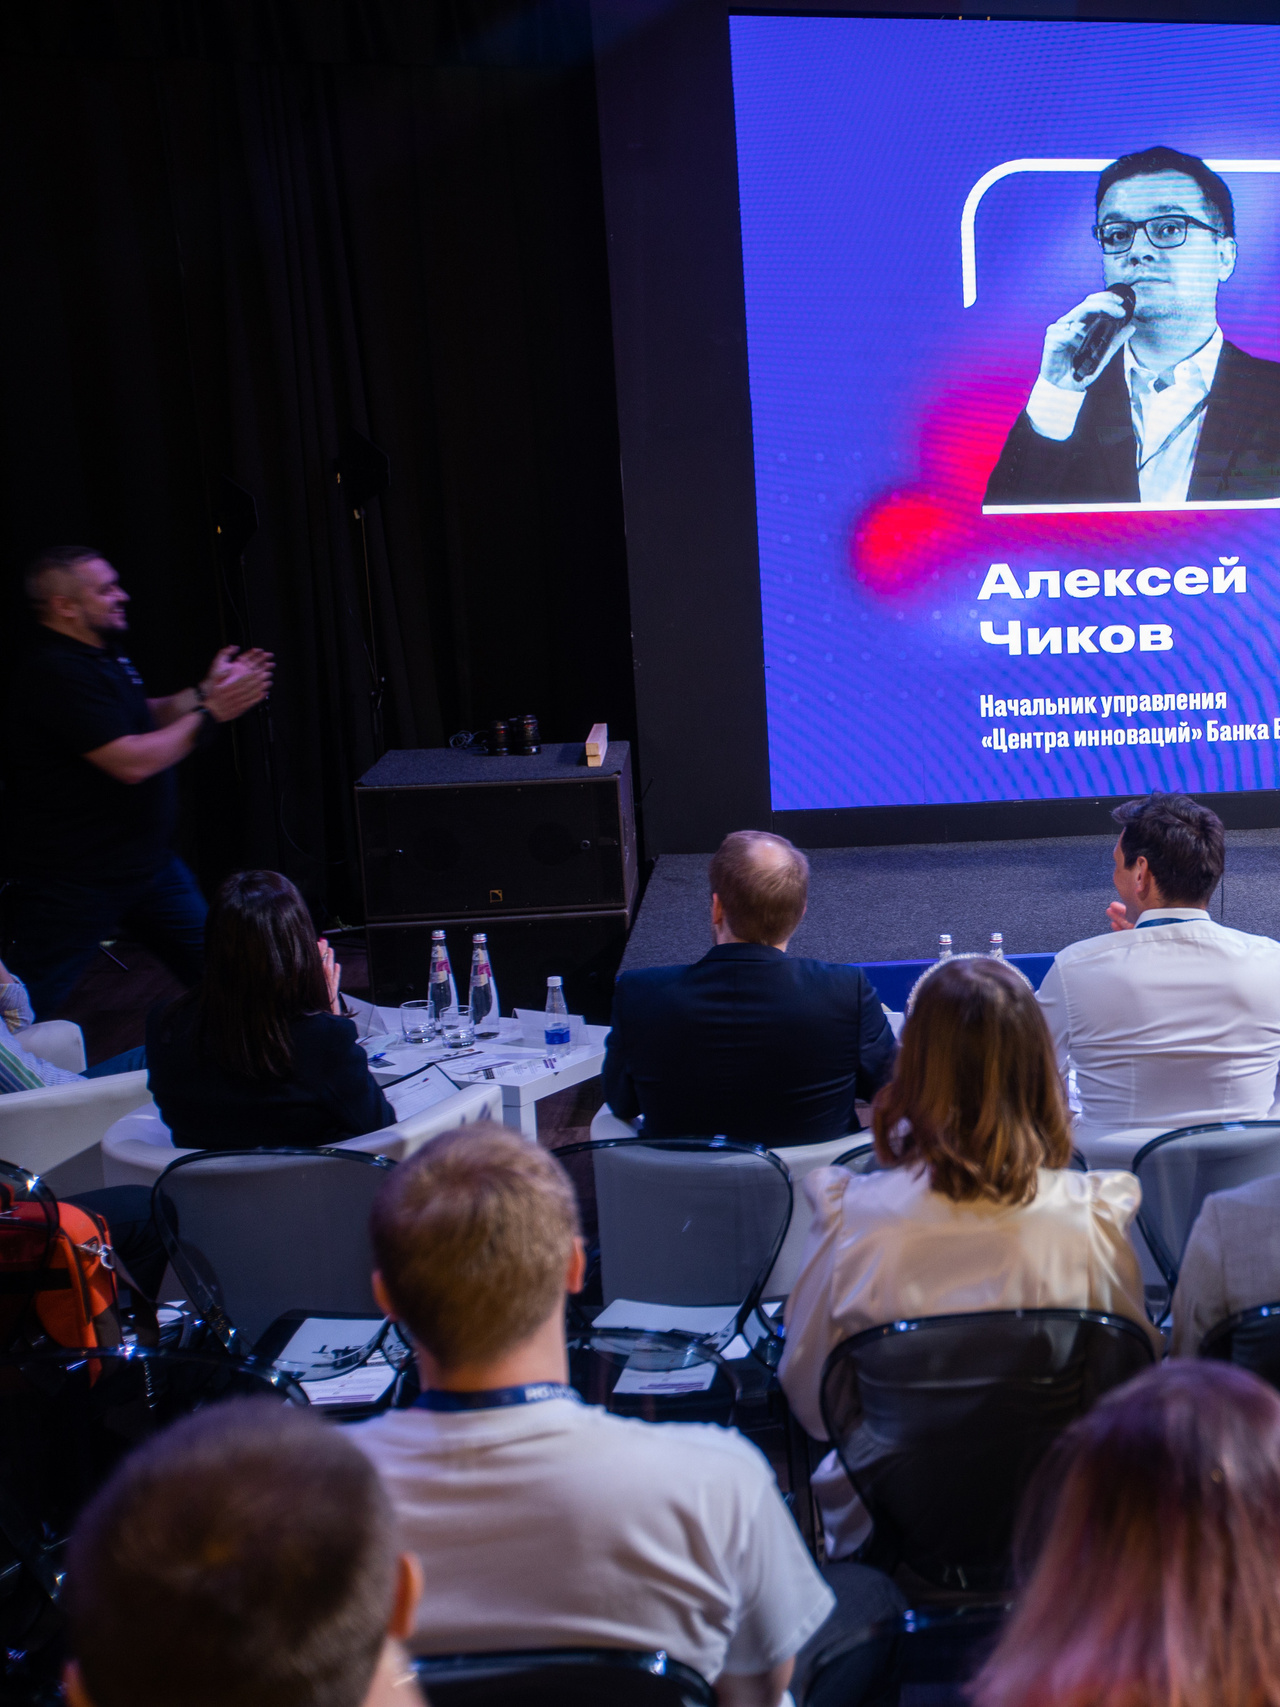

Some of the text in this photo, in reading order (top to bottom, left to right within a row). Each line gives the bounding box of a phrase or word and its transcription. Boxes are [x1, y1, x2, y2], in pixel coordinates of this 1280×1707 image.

[977, 556, 1247, 600] Алексей
[980, 620, 1174, 655] Чиков
[980, 691, 1227, 718] Начальник управления
[981, 727, 1070, 753] «Центра
[1074, 721, 1203, 748] инноваций»
[1207, 719, 1270, 742] Банка
